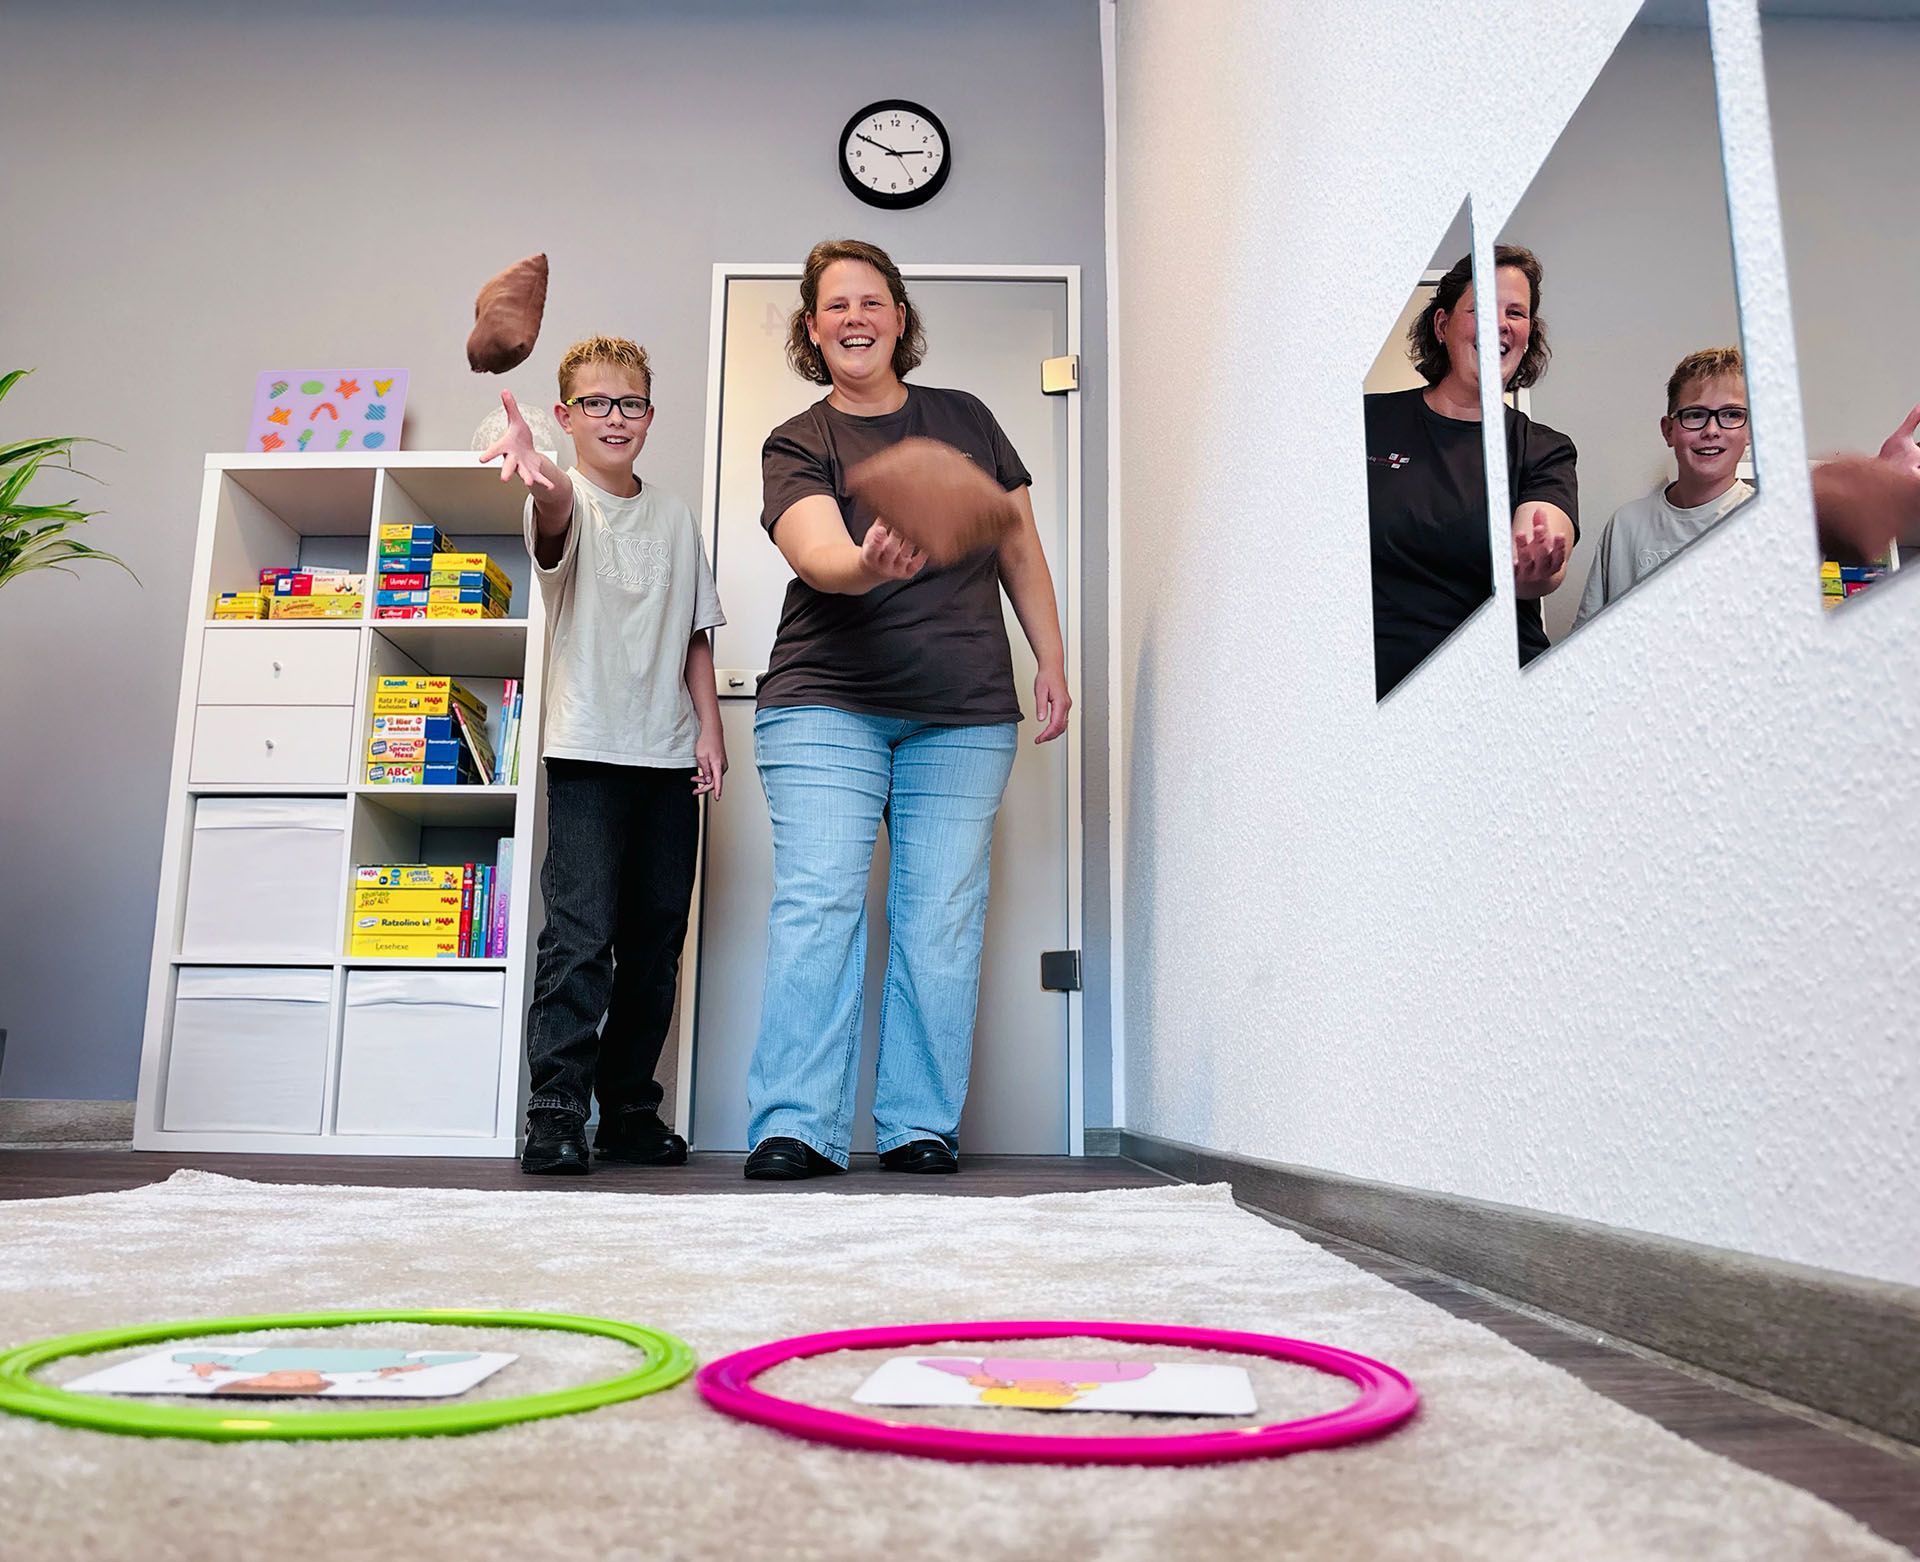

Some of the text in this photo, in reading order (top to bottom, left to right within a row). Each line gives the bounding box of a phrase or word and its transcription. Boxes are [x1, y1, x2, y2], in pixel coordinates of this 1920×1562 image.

[386, 767, 412, 777] ABC-
[391, 776, 414, 784] Insel
[381, 918, 421, 927] Ratzolino
[376, 943, 408, 951] Lesehexe
